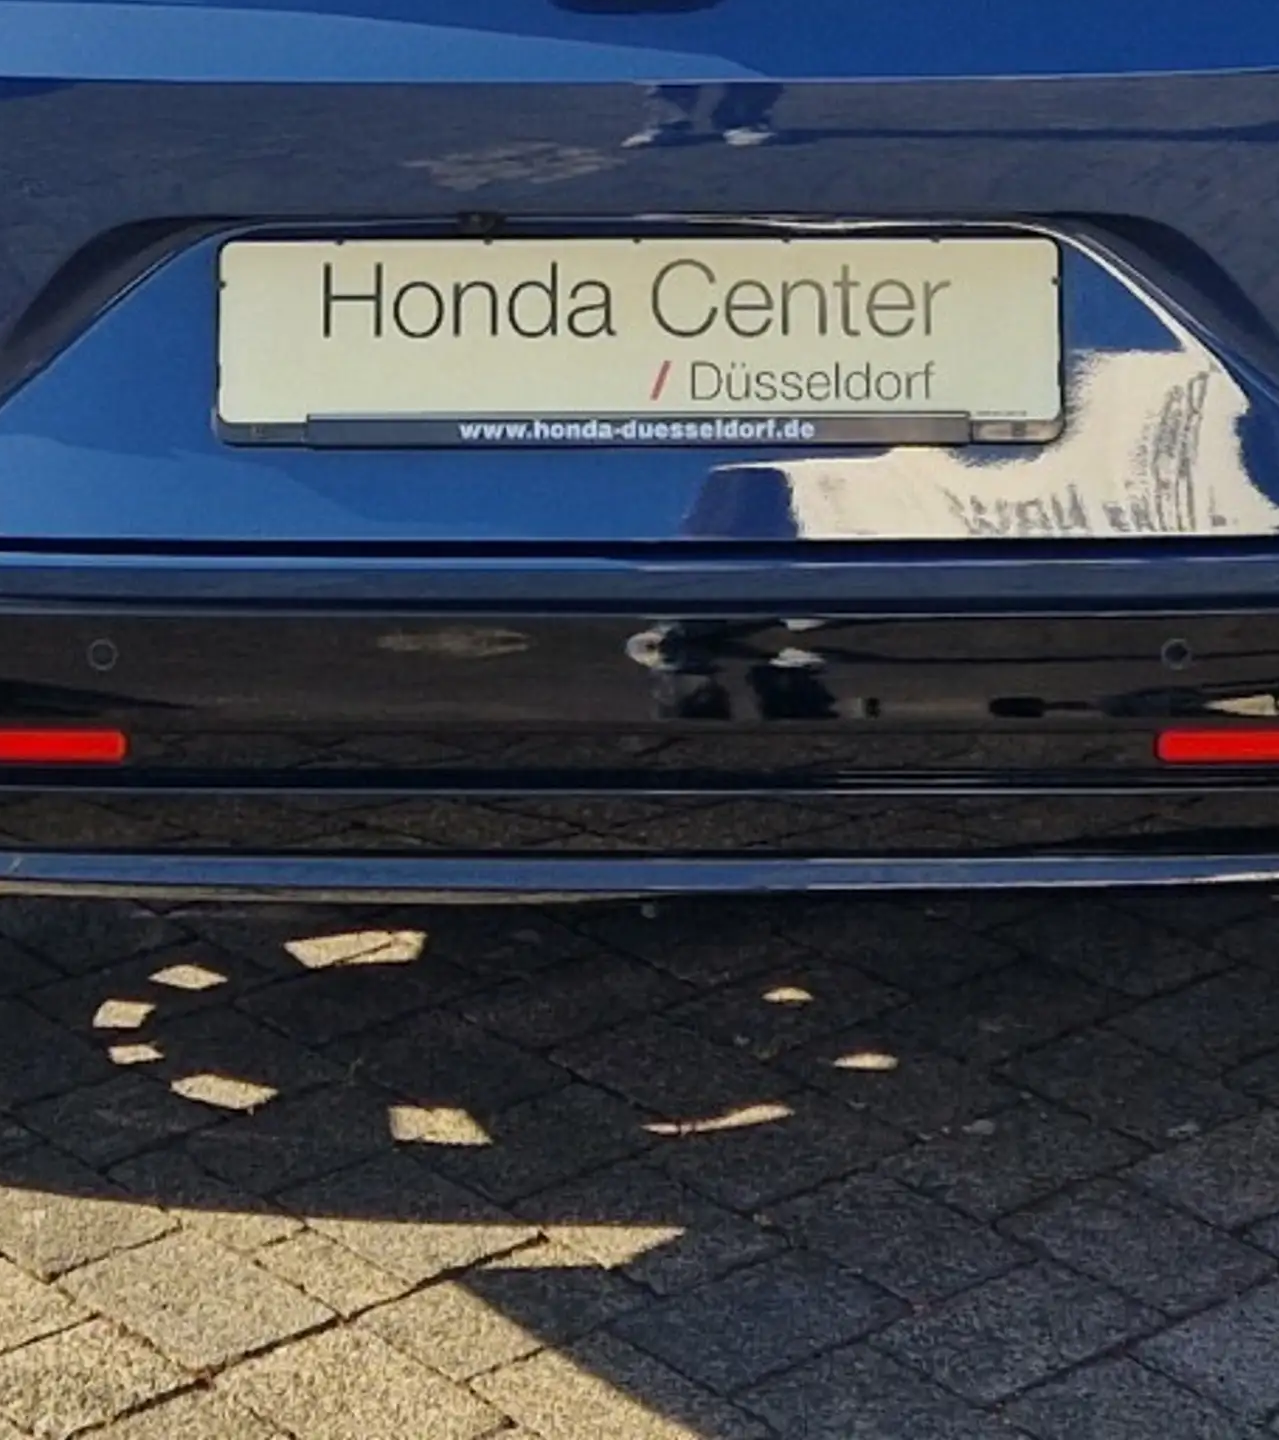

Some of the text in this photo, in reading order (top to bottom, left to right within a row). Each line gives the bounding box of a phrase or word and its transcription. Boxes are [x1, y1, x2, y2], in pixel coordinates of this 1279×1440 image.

[322, 258, 952, 339] Honda Center
[690, 360, 936, 402] Düsseldorf
[459, 417, 816, 441] www.honda-duesseldorf.de
